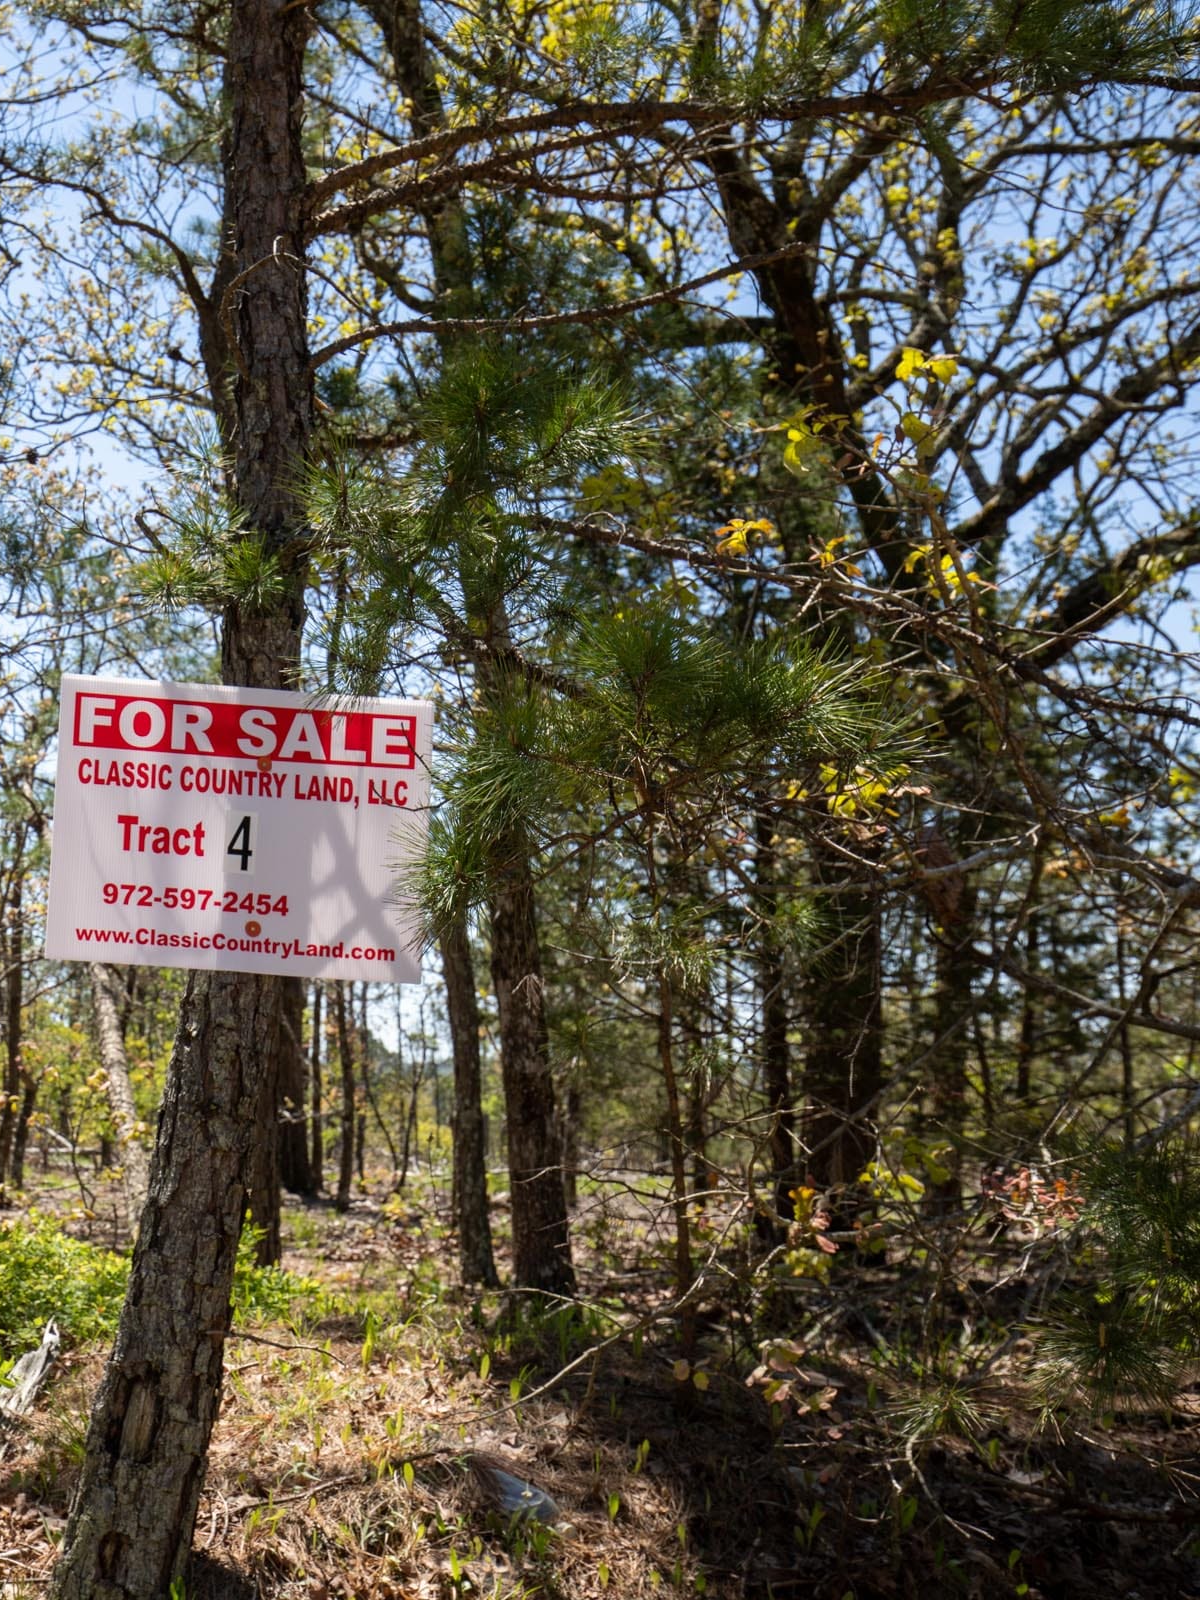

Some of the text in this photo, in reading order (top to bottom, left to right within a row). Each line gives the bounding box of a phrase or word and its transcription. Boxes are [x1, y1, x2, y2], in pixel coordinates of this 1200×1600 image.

[78, 696, 411, 766] FOR SALE
[78, 758, 409, 809] CLASSIC COUNTRY LAND, LLC
[117, 814, 253, 872] Tract 4
[102, 883, 289, 917] 972-597-2454
[75, 926, 396, 962] www.ClassicCountryLand.com
